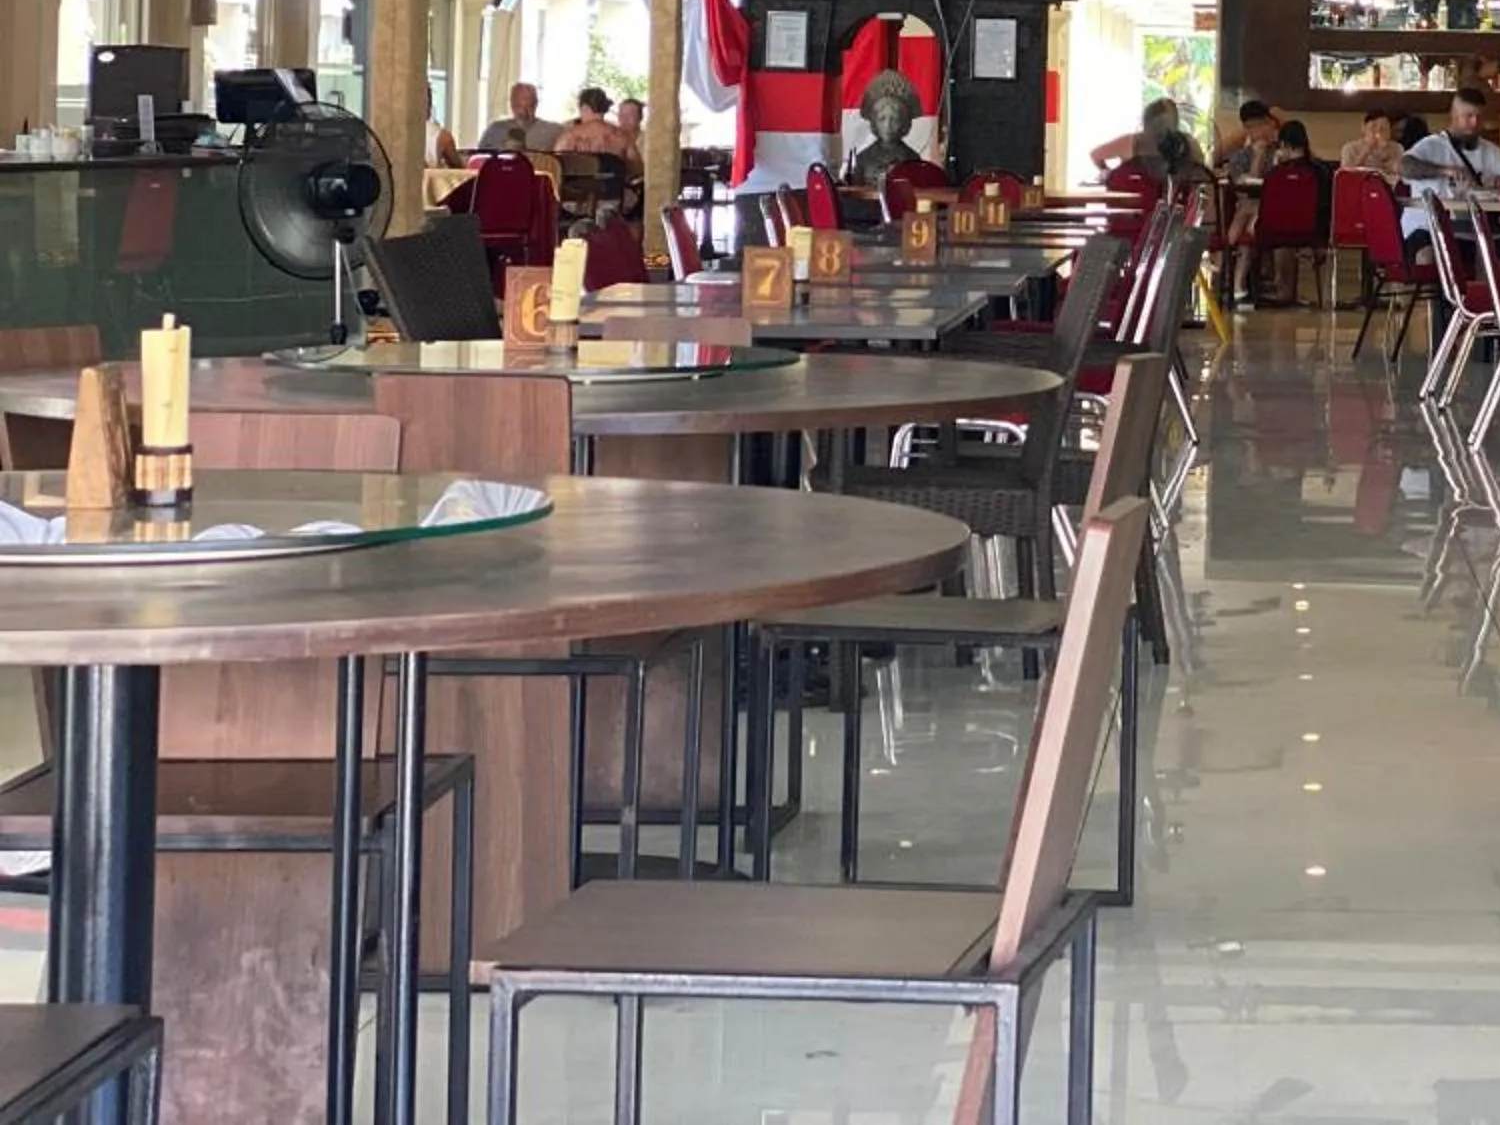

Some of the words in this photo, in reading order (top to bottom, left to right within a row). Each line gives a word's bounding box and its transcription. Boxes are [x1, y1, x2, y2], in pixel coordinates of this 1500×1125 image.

[911, 219, 930, 249] 9
[954, 210, 975, 235] 10
[819, 240, 841, 275] 8
[753, 257, 781, 302] 7
[520, 283, 551, 336] 6
